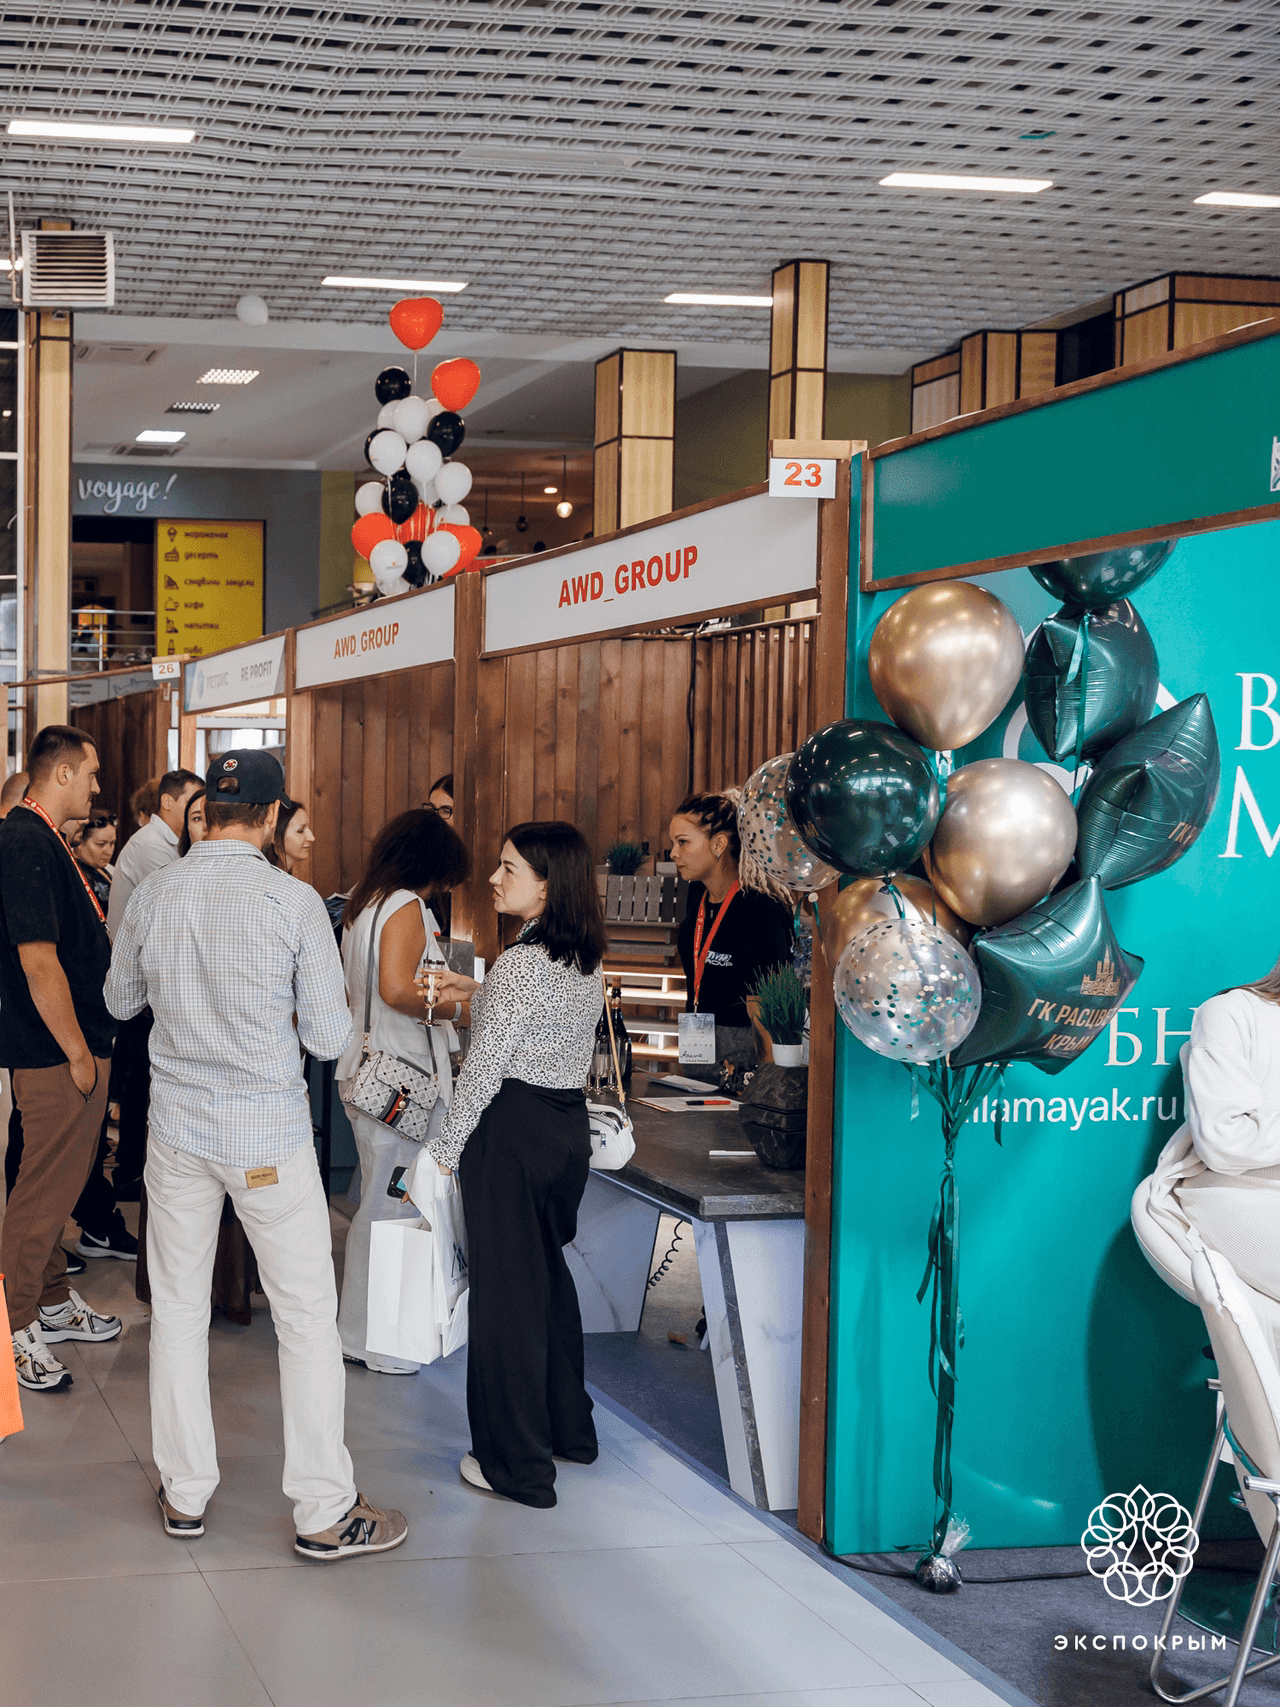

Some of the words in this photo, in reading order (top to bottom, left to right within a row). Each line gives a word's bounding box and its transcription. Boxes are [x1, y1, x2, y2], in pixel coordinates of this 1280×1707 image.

[783, 462, 823, 487] 23
[558, 545, 698, 609] AWD_GROUP
[334, 622, 399, 659] AWD_GROUP
[158, 664, 174, 675] 26
[250, 660, 273, 679] PROFIT
[1027, 998, 1057, 1021] ГК
